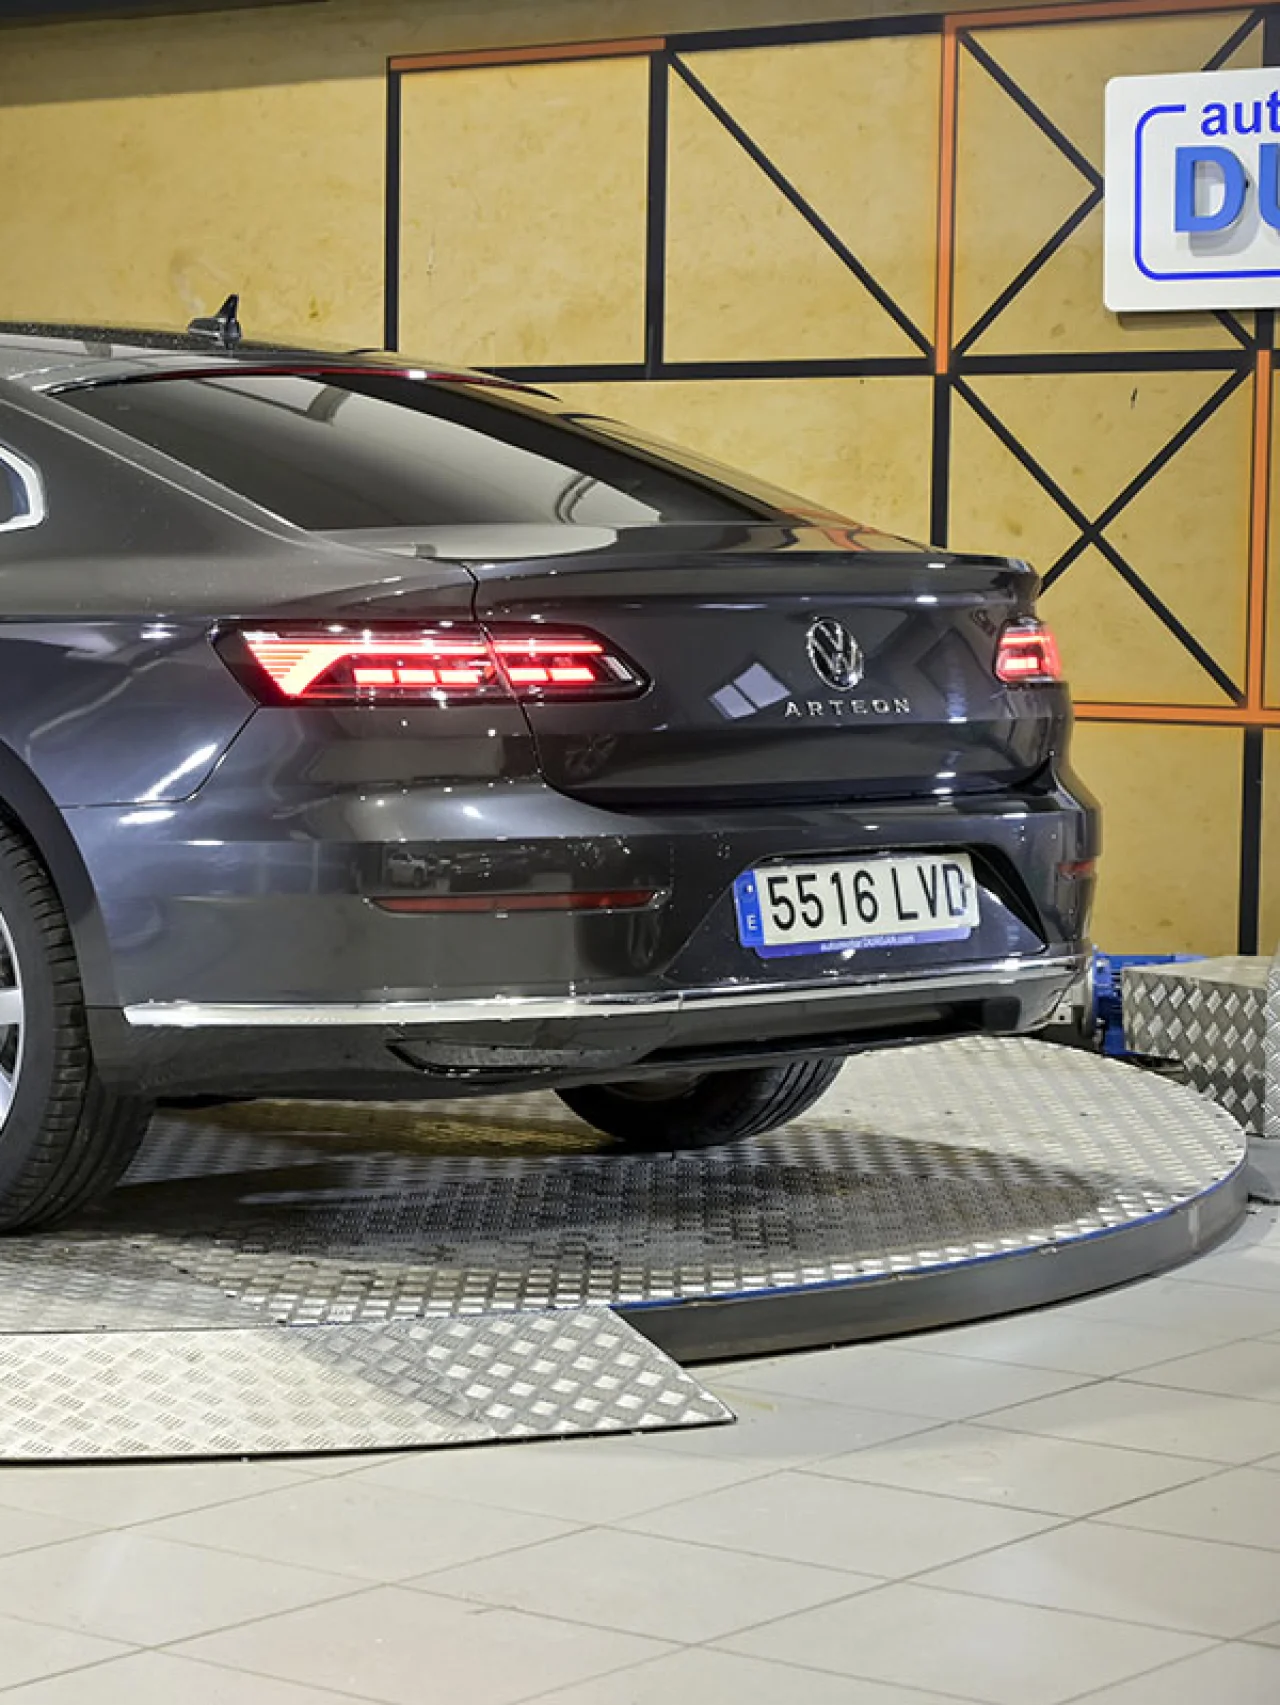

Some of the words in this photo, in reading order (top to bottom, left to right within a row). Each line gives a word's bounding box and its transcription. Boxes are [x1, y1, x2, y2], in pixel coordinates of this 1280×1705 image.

[784, 698, 911, 718] ARTEON
[746, 914, 758, 931] E
[766, 869, 879, 931] 5516
[891, 863, 969, 921] LVD
